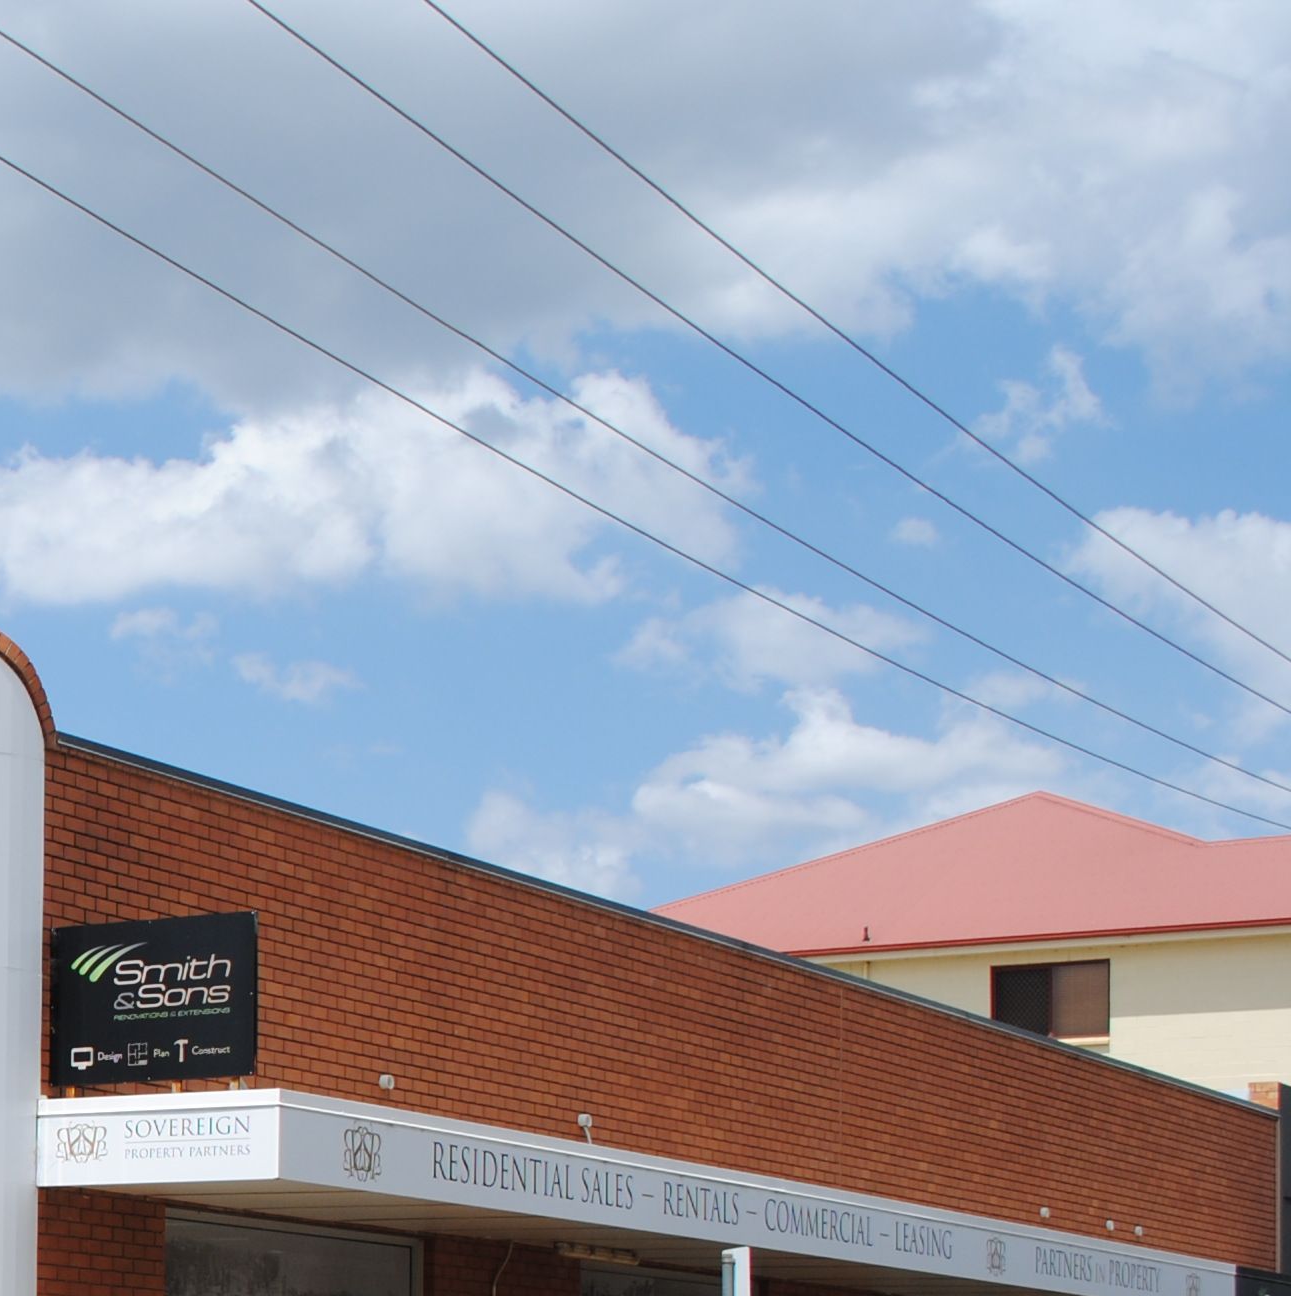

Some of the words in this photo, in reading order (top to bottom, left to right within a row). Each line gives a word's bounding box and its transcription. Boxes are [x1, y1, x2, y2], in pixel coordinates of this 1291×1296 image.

[113, 954, 231, 985] Smith
[97, 1051, 123, 1063] Design
[153, 1048, 170, 1058] Plan
[191, 1045, 231, 1056] Construct
[124, 1115, 251, 1138] SOVEREIGN
[124, 1146, 185, 1160] PROPERTY
[189, 1144, 251, 1157] PARTNERS
[432, 1140, 575, 1202] RESIDENTIAL
[581, 1167, 634, 1210] SALES
[663, 1181, 739, 1226] RENTALS
[763, 1198, 873, 1248] COMMERCIAL
[894, 1219, 953, 1260] LEASING
[1035, 1246, 1092, 1284] PARTNERS
[1095, 1264, 1105, 1284] IN
[1109, 1259, 1161, 1293] PROPERTY
